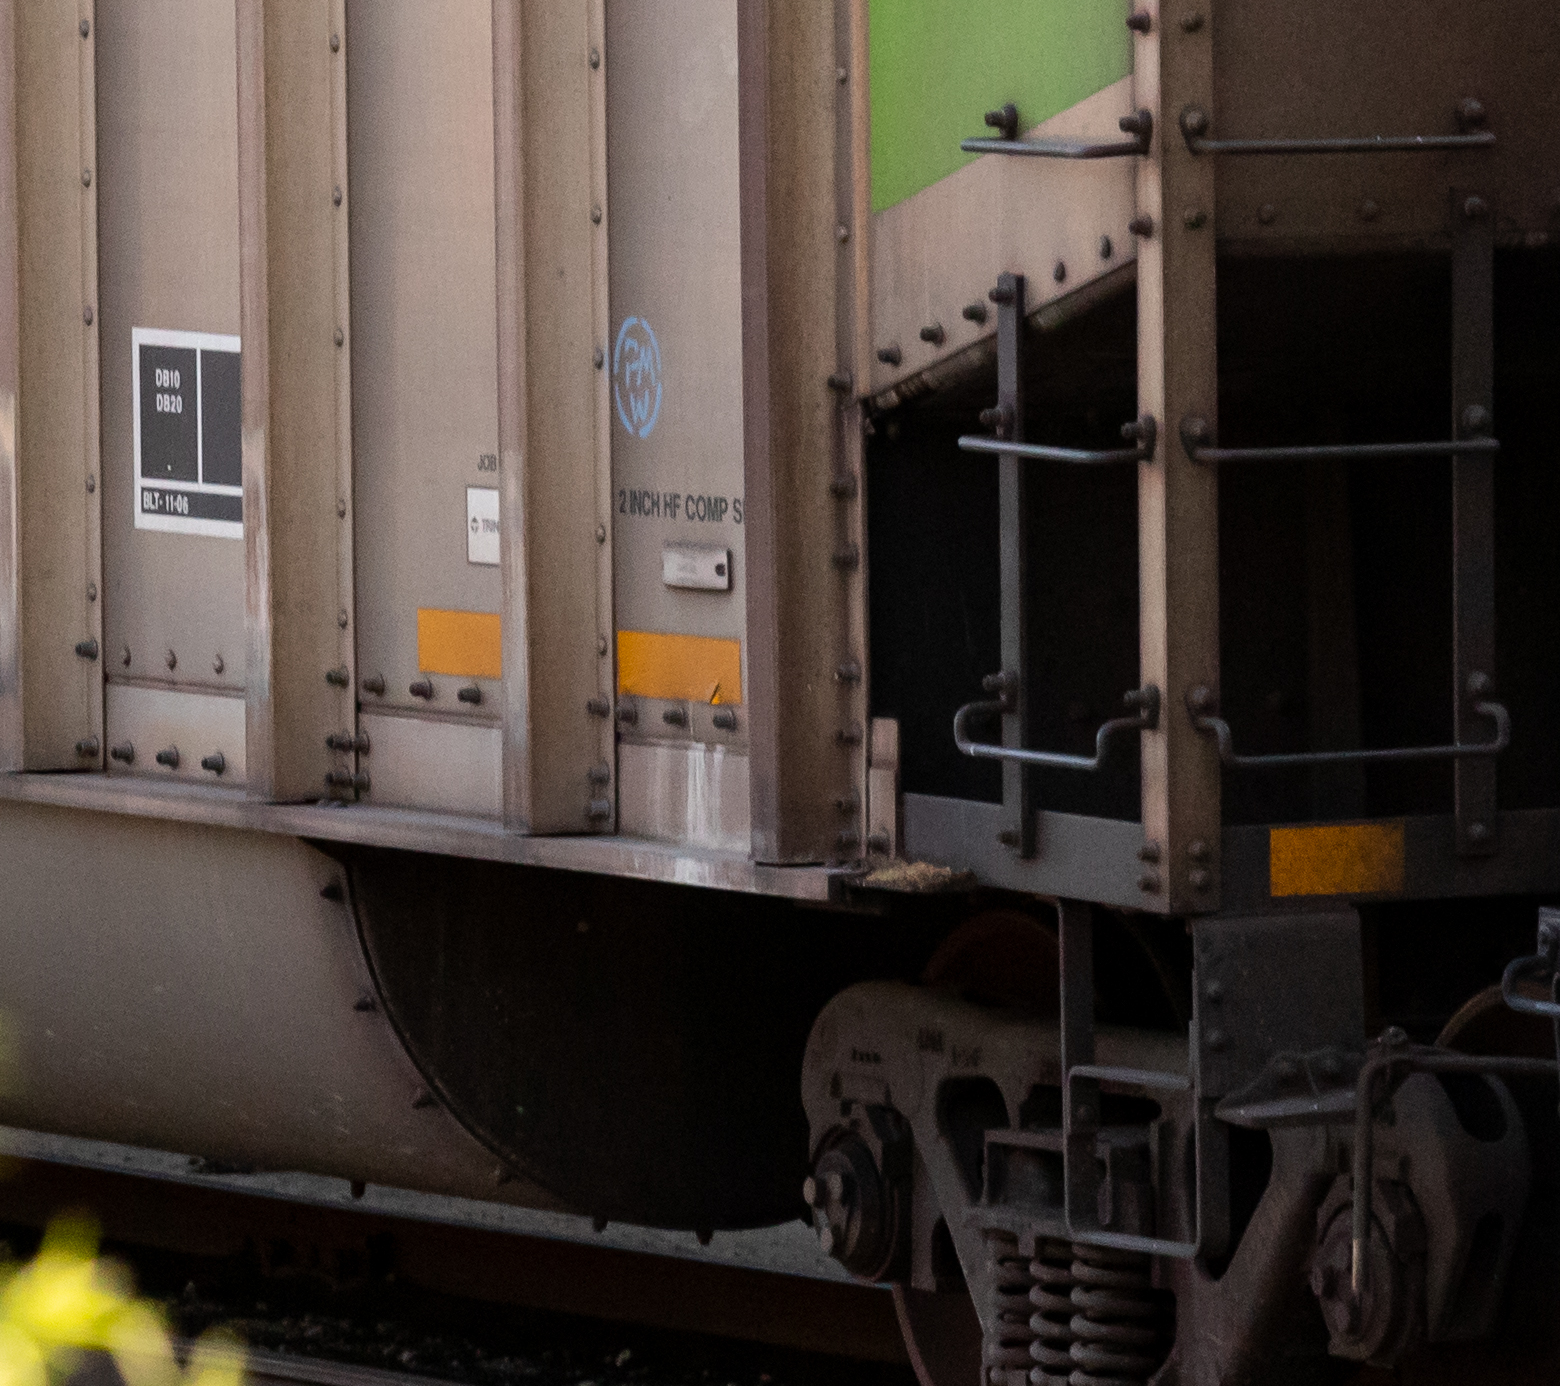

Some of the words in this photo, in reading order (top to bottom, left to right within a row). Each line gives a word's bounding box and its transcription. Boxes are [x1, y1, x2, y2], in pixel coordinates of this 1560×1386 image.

[155, 368, 181, 390] DB10
[156, 393, 183, 414] DB20
[618, 489, 626, 514] 2
[630, 490, 660, 517] INCH
[685, 495, 728, 522] COMP
